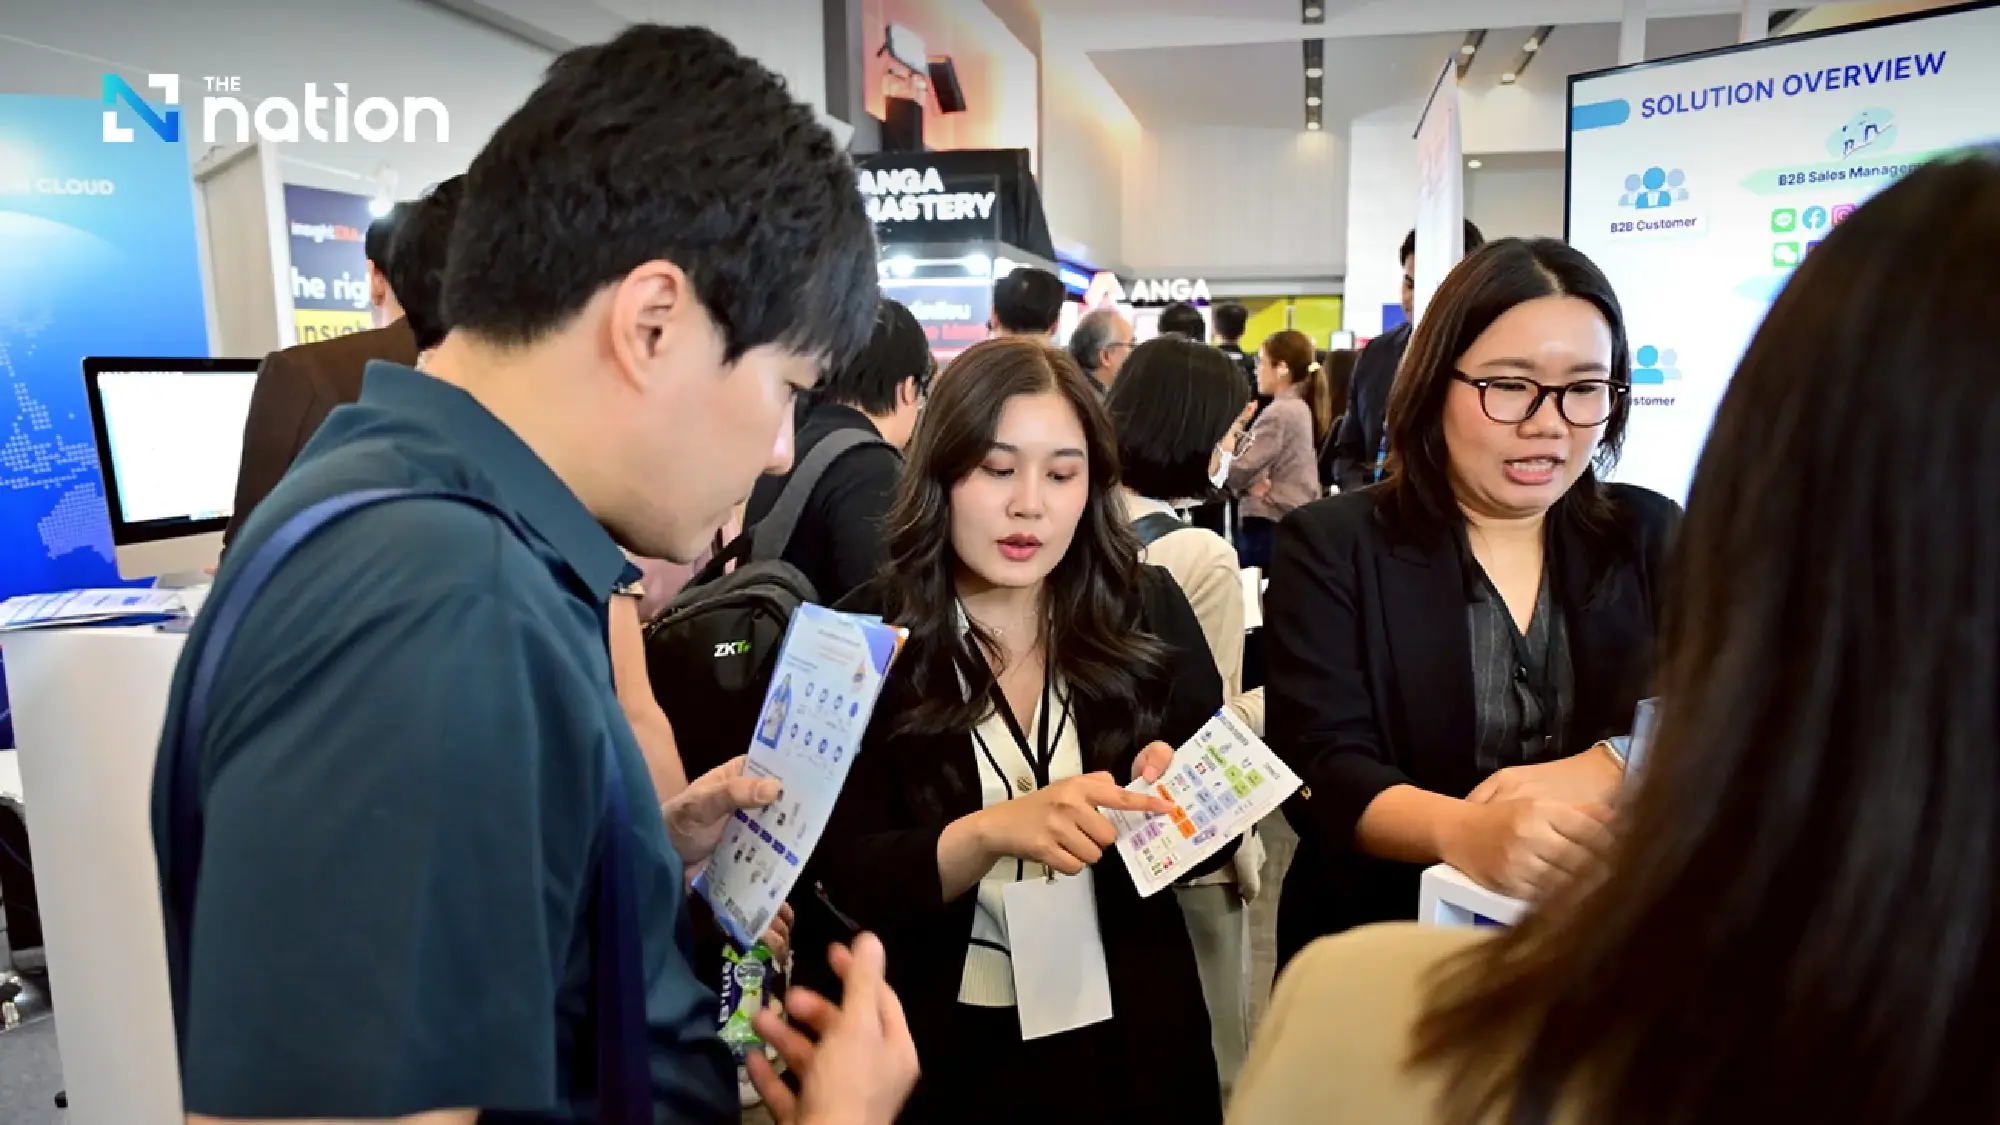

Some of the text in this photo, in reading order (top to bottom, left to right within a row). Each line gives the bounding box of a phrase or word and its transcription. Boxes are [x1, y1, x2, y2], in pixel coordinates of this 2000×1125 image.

[1641, 50, 1946, 119] SOLUTION OVERVIEW
[36, 178, 115, 195] CLOUD
[859, 167, 945, 195] ANGA
[1778, 173, 1806, 186] B2B
[1808, 170, 1846, 183] Sales
[1610, 217, 1698, 233] B2B Customer
[292, 266, 326, 298] he
[1131, 278, 1212, 302] ANGA
